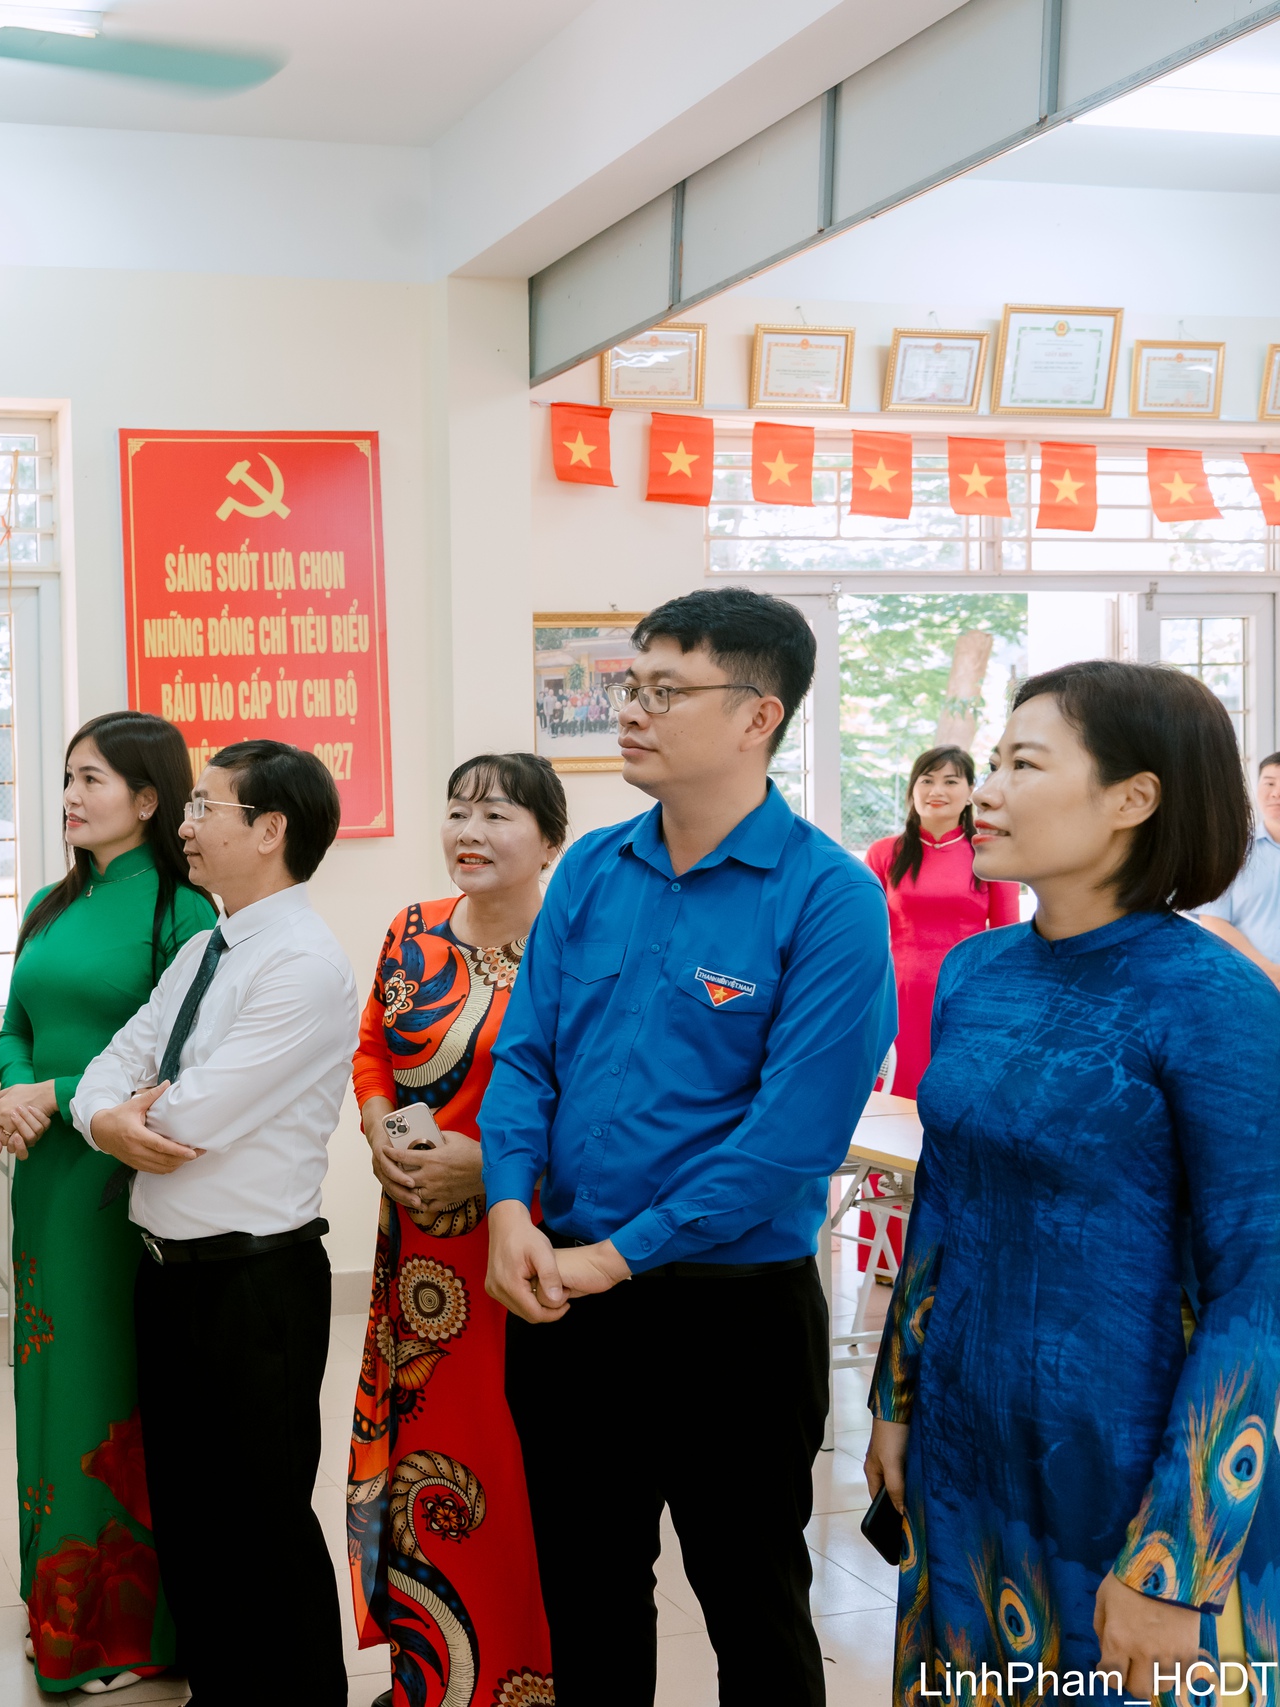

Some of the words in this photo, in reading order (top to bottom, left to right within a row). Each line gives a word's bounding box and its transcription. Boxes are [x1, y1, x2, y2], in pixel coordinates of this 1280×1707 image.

[165, 545, 212, 592] SÁNG
[216, 538, 259, 592] SUỐT
[263, 548, 296, 599] LỰA
[299, 551, 345, 598] CHỌN
[144, 611, 204, 658] NHỮNG
[207, 604, 255, 656] ĐỒNG
[259, 607, 287, 654] CHÍ
[291, 607, 327, 654] TIÊU
[331, 599, 369, 653] BIỂU
[161, 669, 196, 722] BẦU
[200, 674, 234, 721] VÀO
[238, 667, 272, 720] CẤP
[276, 667, 298, 719] ỦY
[302, 679, 331, 718] CHI
[334, 670, 358, 725] BỘ
